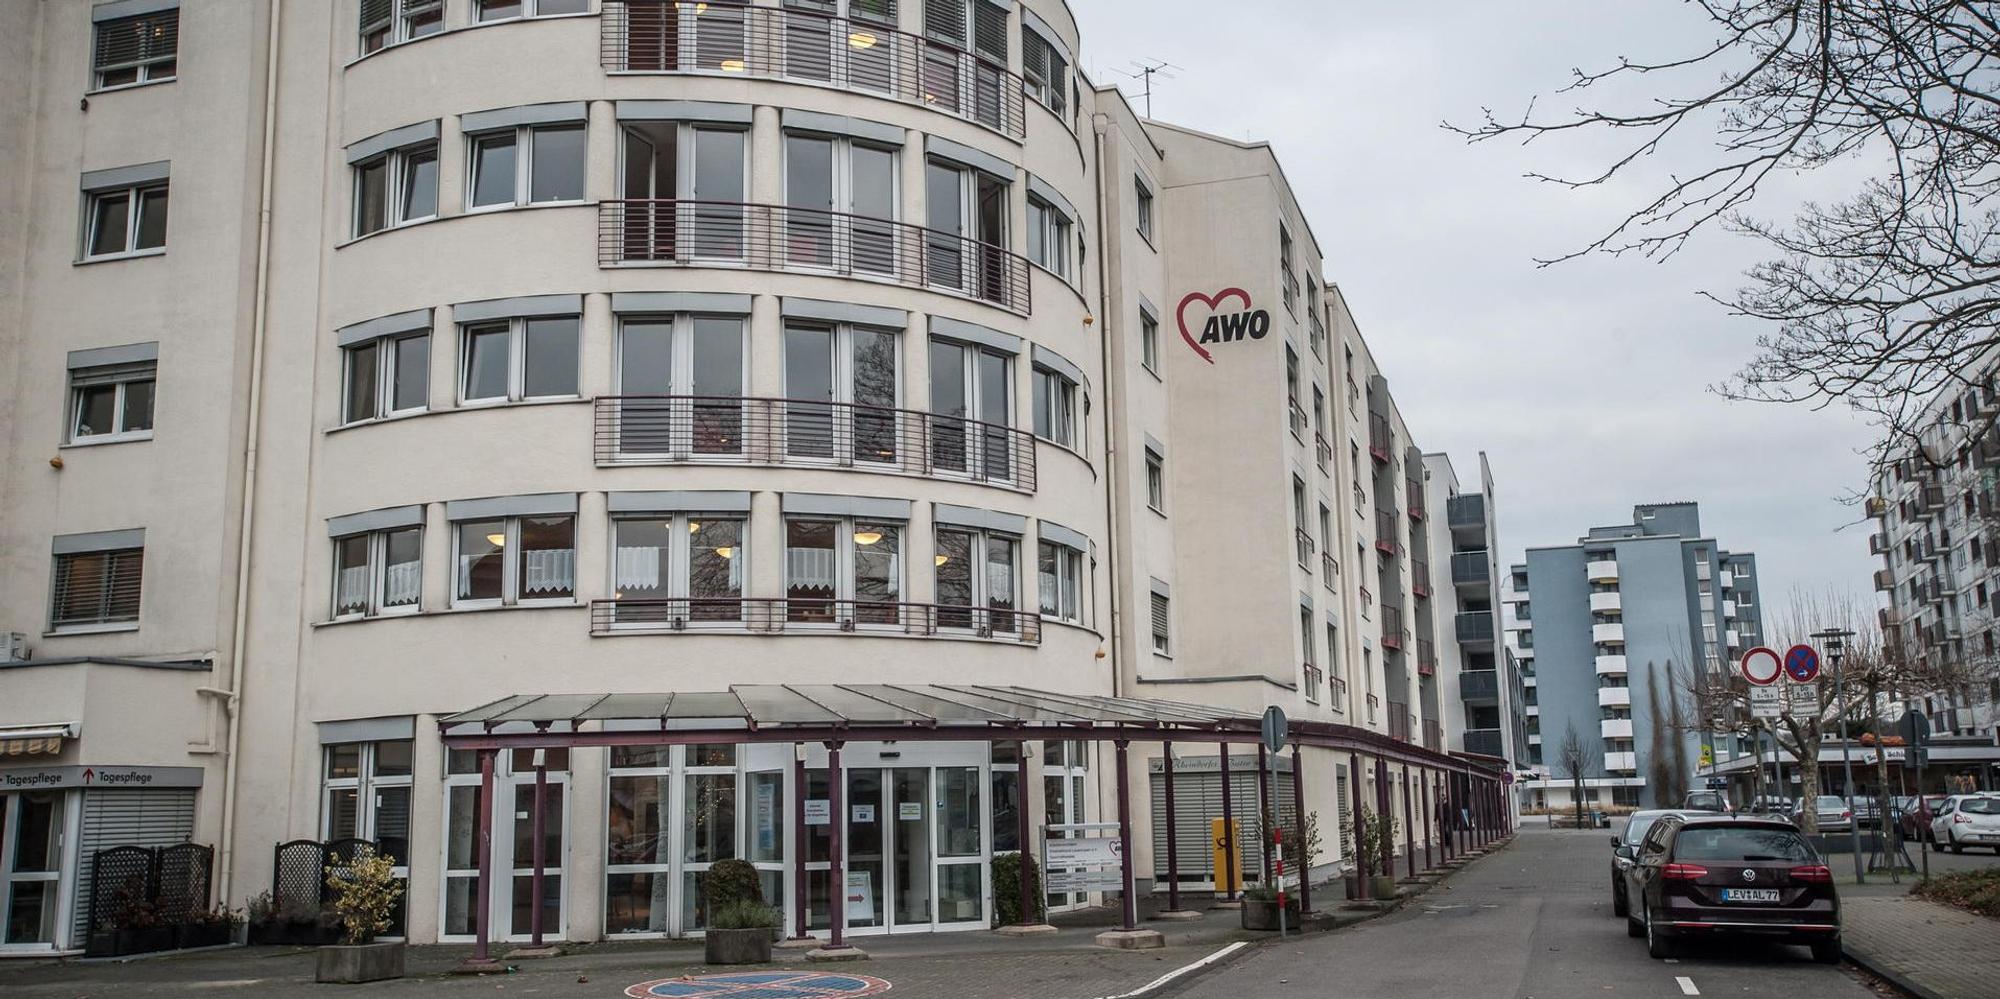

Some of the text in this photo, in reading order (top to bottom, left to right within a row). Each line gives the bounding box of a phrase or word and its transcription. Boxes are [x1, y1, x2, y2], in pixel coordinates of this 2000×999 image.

[1199, 309, 1270, 344] AWO
[5, 773, 62, 787] Tagespflege
[99, 771, 152, 784] Tagespflege
[1728, 889, 1778, 900] LEV AL 77
